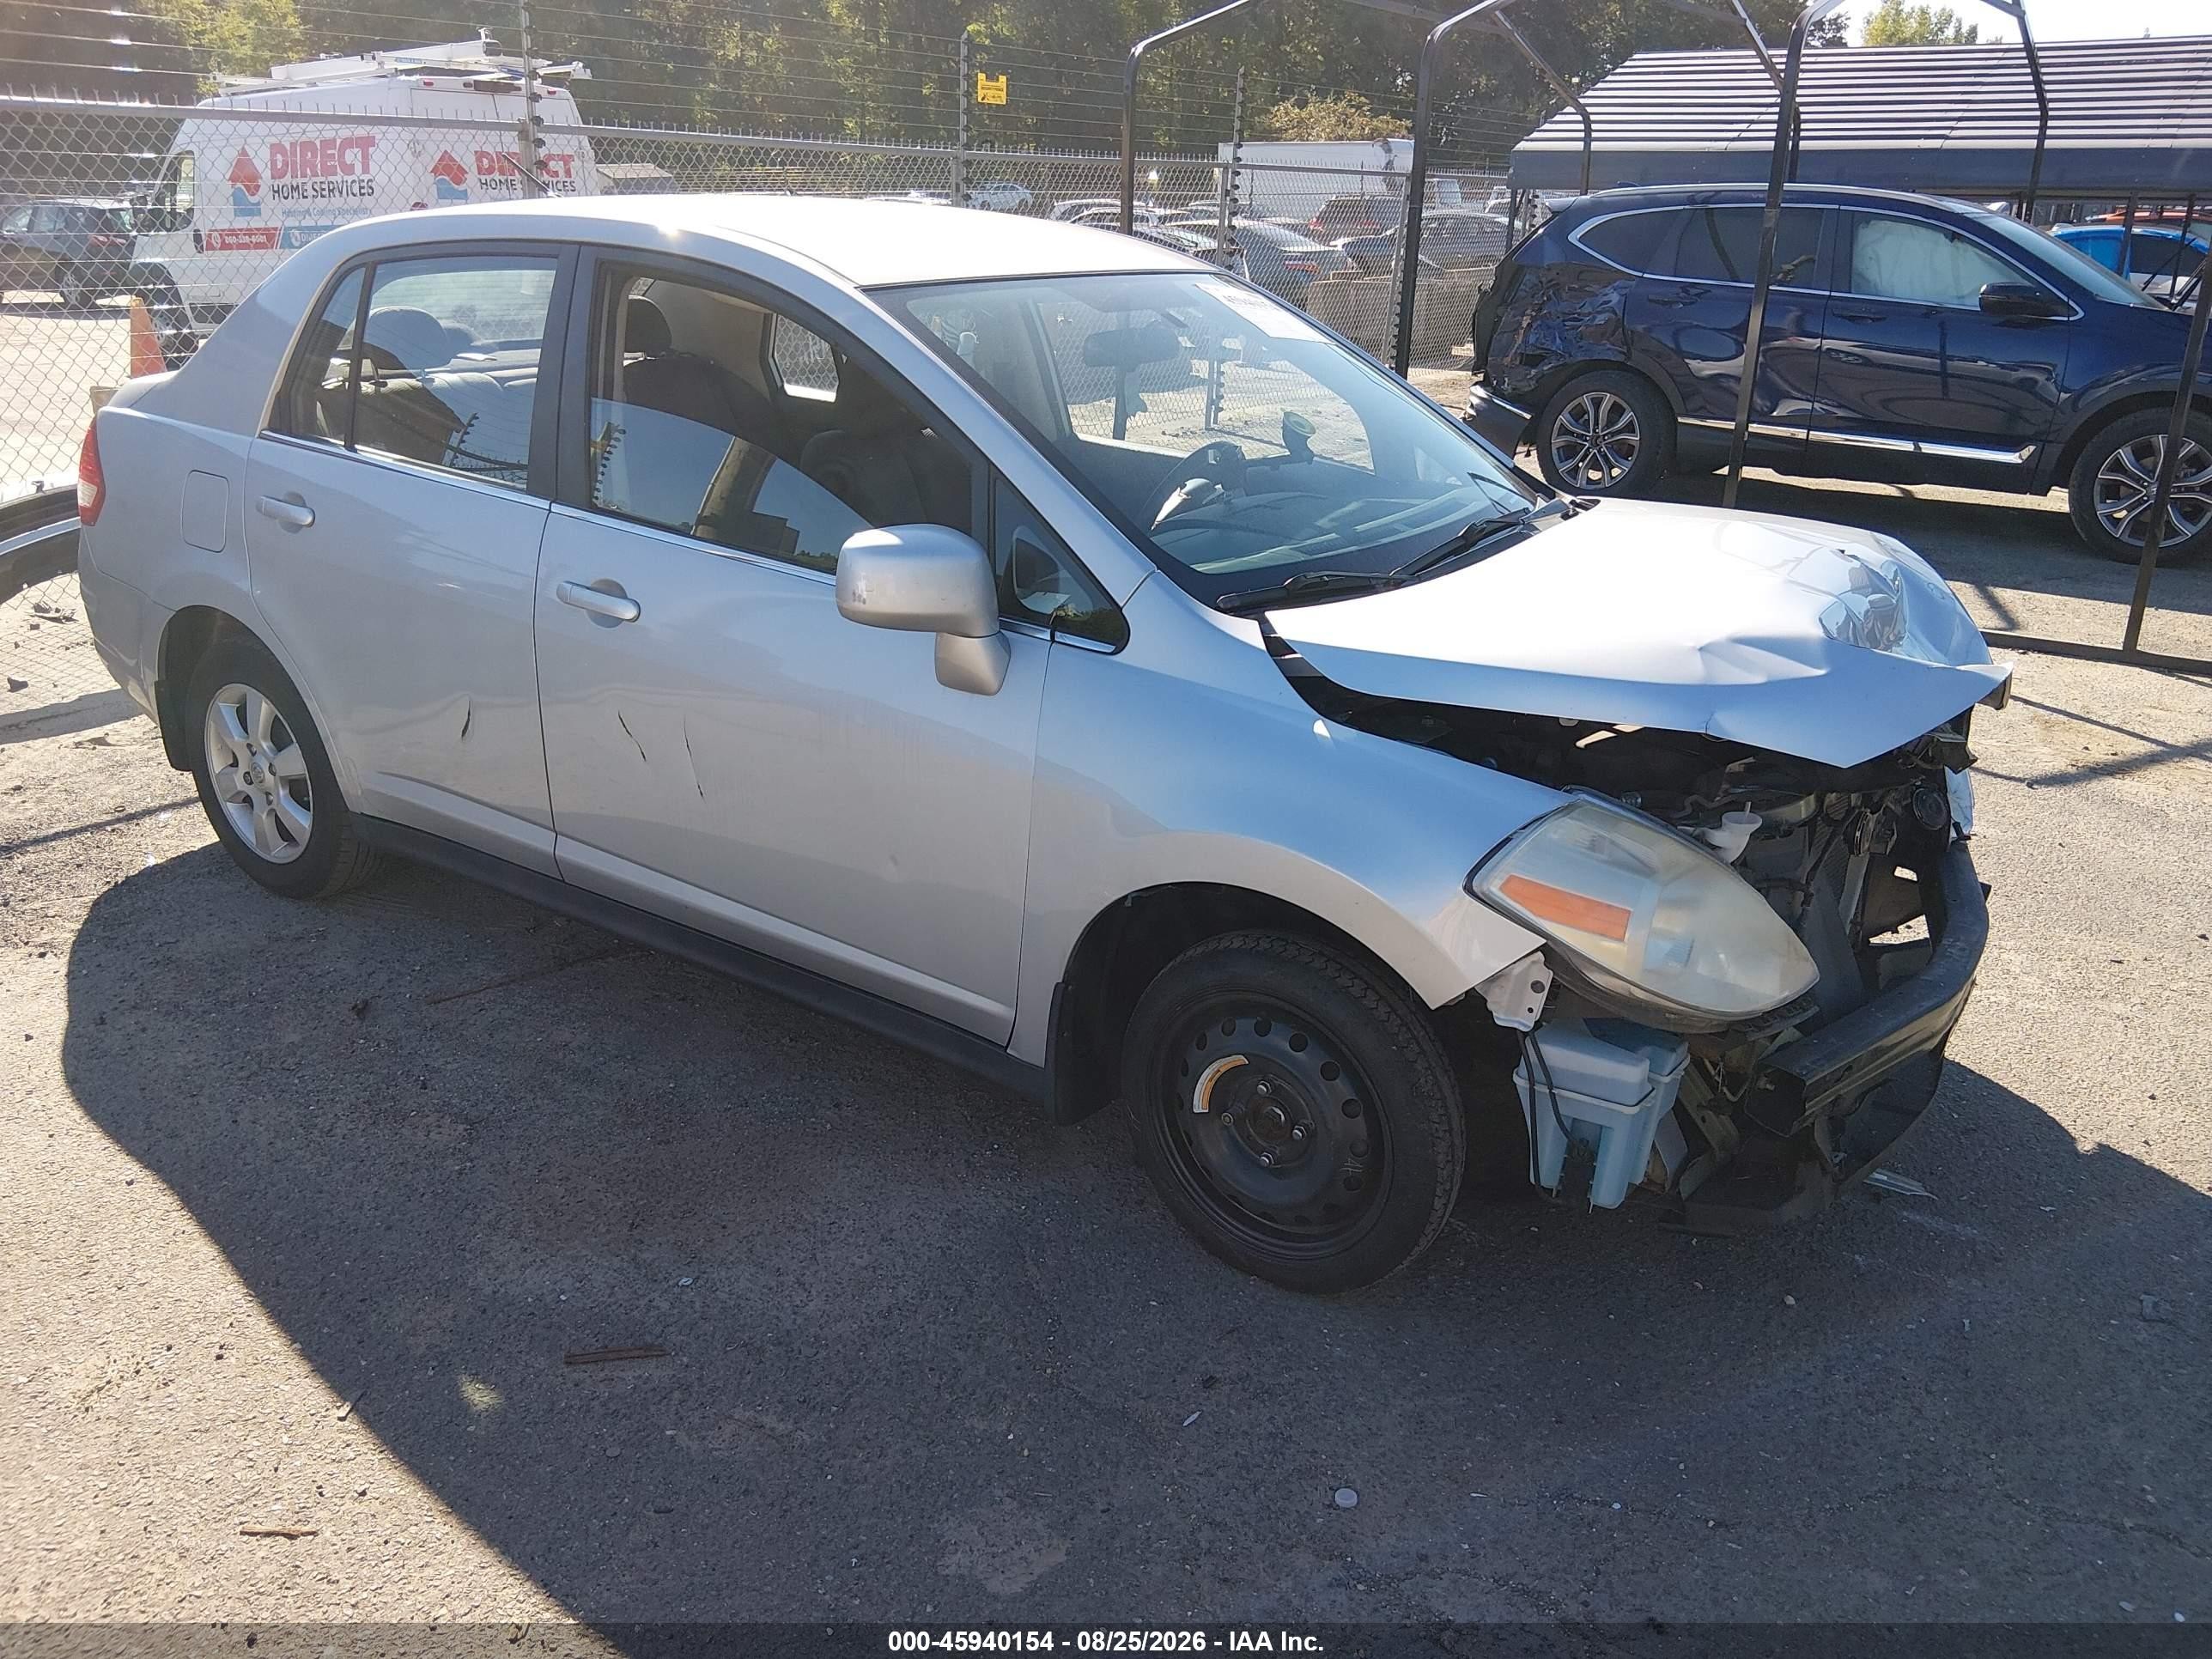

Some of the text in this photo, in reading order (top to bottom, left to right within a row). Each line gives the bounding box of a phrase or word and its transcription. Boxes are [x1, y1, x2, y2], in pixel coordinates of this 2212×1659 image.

[270, 136, 375, 179] DIRECT
[474, 150, 574, 178] DIRCT
[271, 179, 375, 200] HOME SERVICES
[479, 179, 516, 191] HOME
